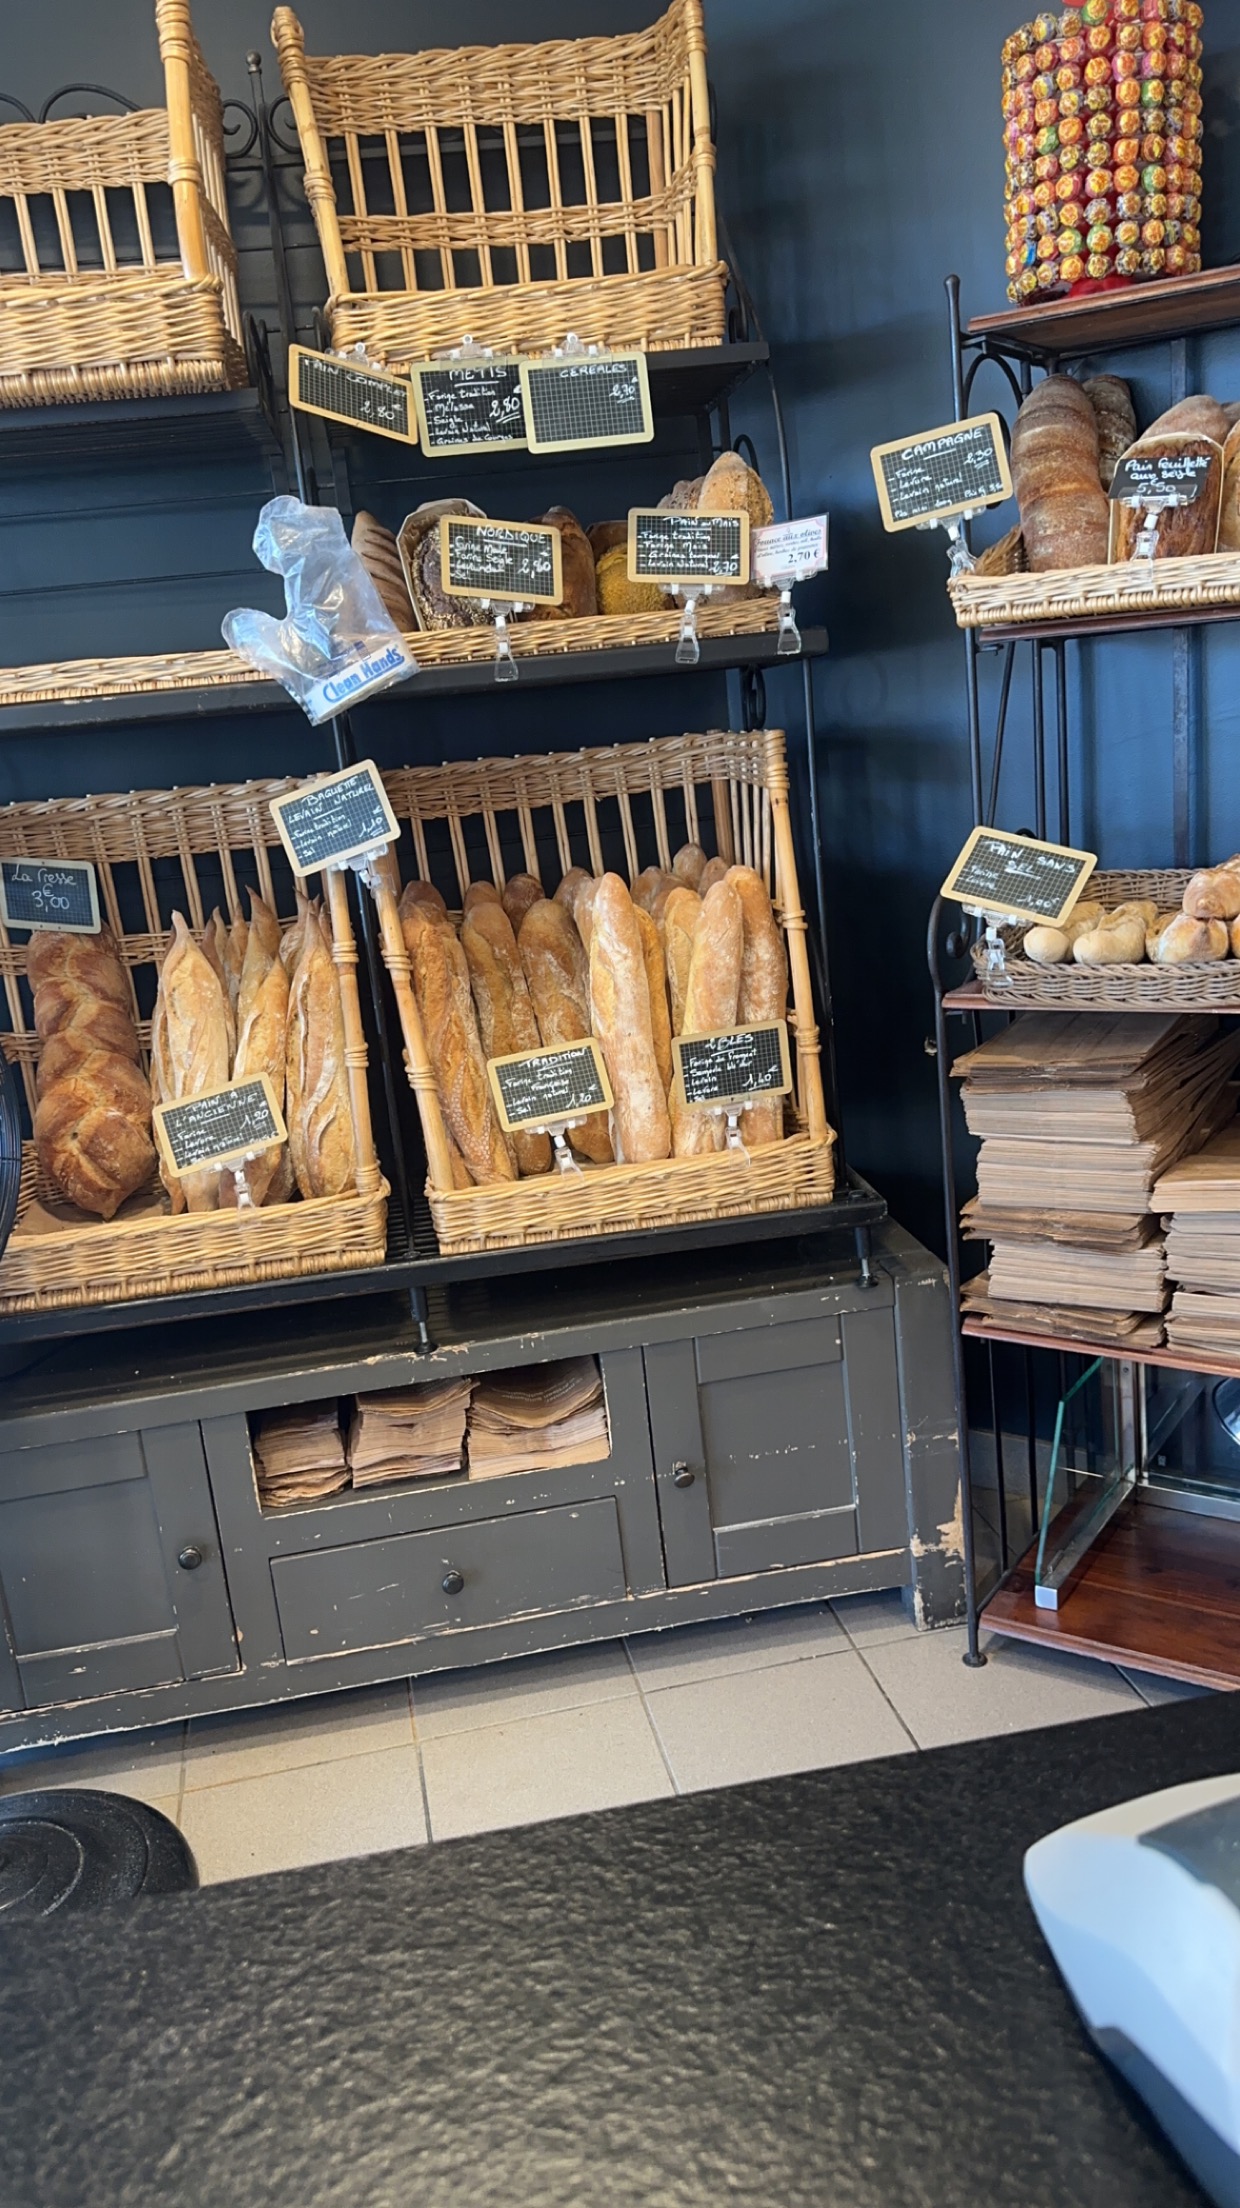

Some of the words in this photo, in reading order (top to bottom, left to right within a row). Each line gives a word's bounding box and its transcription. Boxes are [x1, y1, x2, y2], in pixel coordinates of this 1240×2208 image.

[901, 427, 984, 460] CAMPAGNE
[1125, 459, 1153, 472] Pain
[476, 524, 549, 544] NORDIQUE
[788, 551, 811, 564] 2,70
[322, 670, 362, 703] Clean
[361, 646, 406, 679] Hands
[301, 776, 358, 806] BAGUETTE
[288, 802, 323, 823] LEVAIN
[333, 783, 375, 805] NATUREL
[12, 864, 33, 882] La
[31, 890, 70, 913] 3,00
